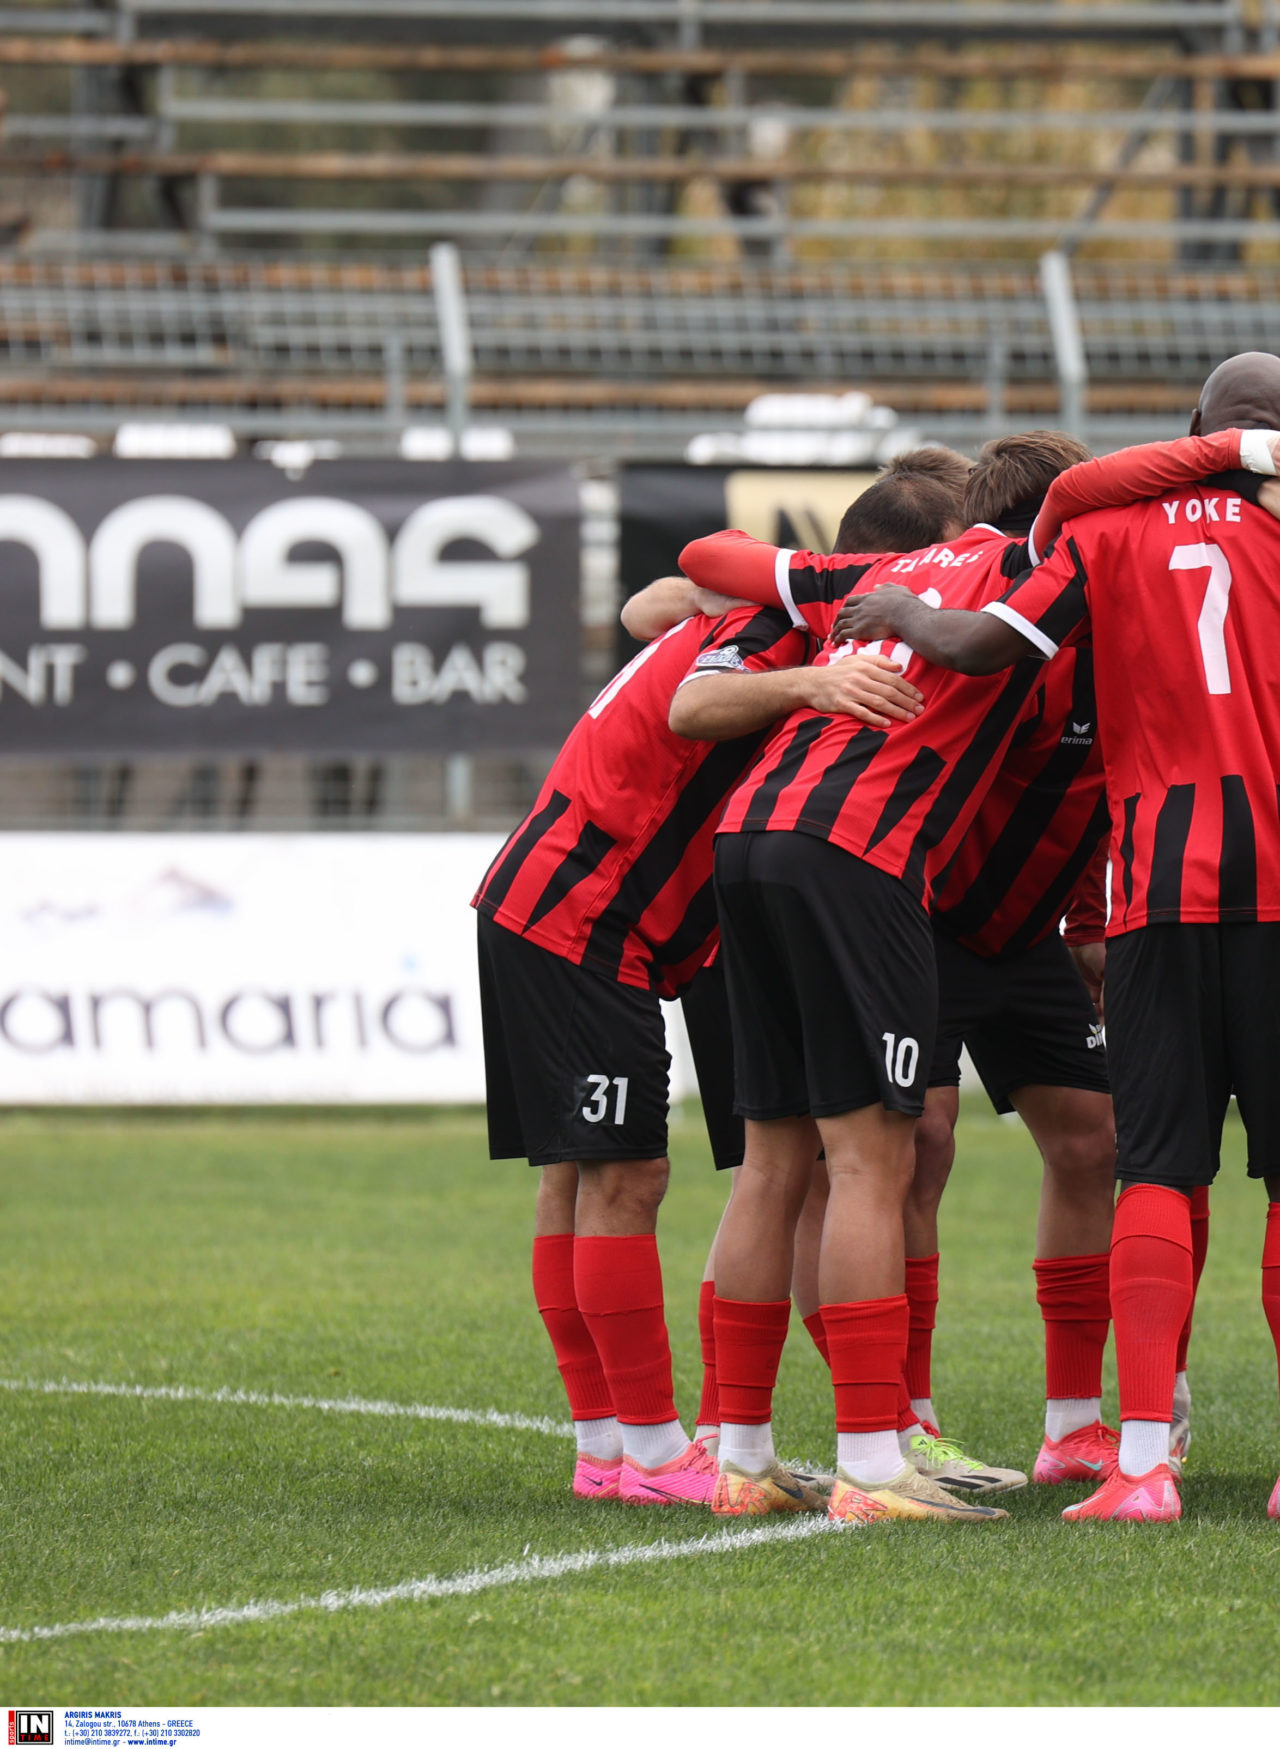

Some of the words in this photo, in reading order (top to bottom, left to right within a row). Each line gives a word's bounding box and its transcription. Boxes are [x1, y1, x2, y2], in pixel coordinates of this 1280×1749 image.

[1162, 497, 1242, 525] YOKE
[1168, 542, 1232, 695] 7
[148, 643, 329, 706] CAFE
[392, 643, 527, 705] BAR
[1060, 736, 1093, 745] erima
[882, 1032, 919, 1087] 10
[582, 1074, 629, 1126] 31
